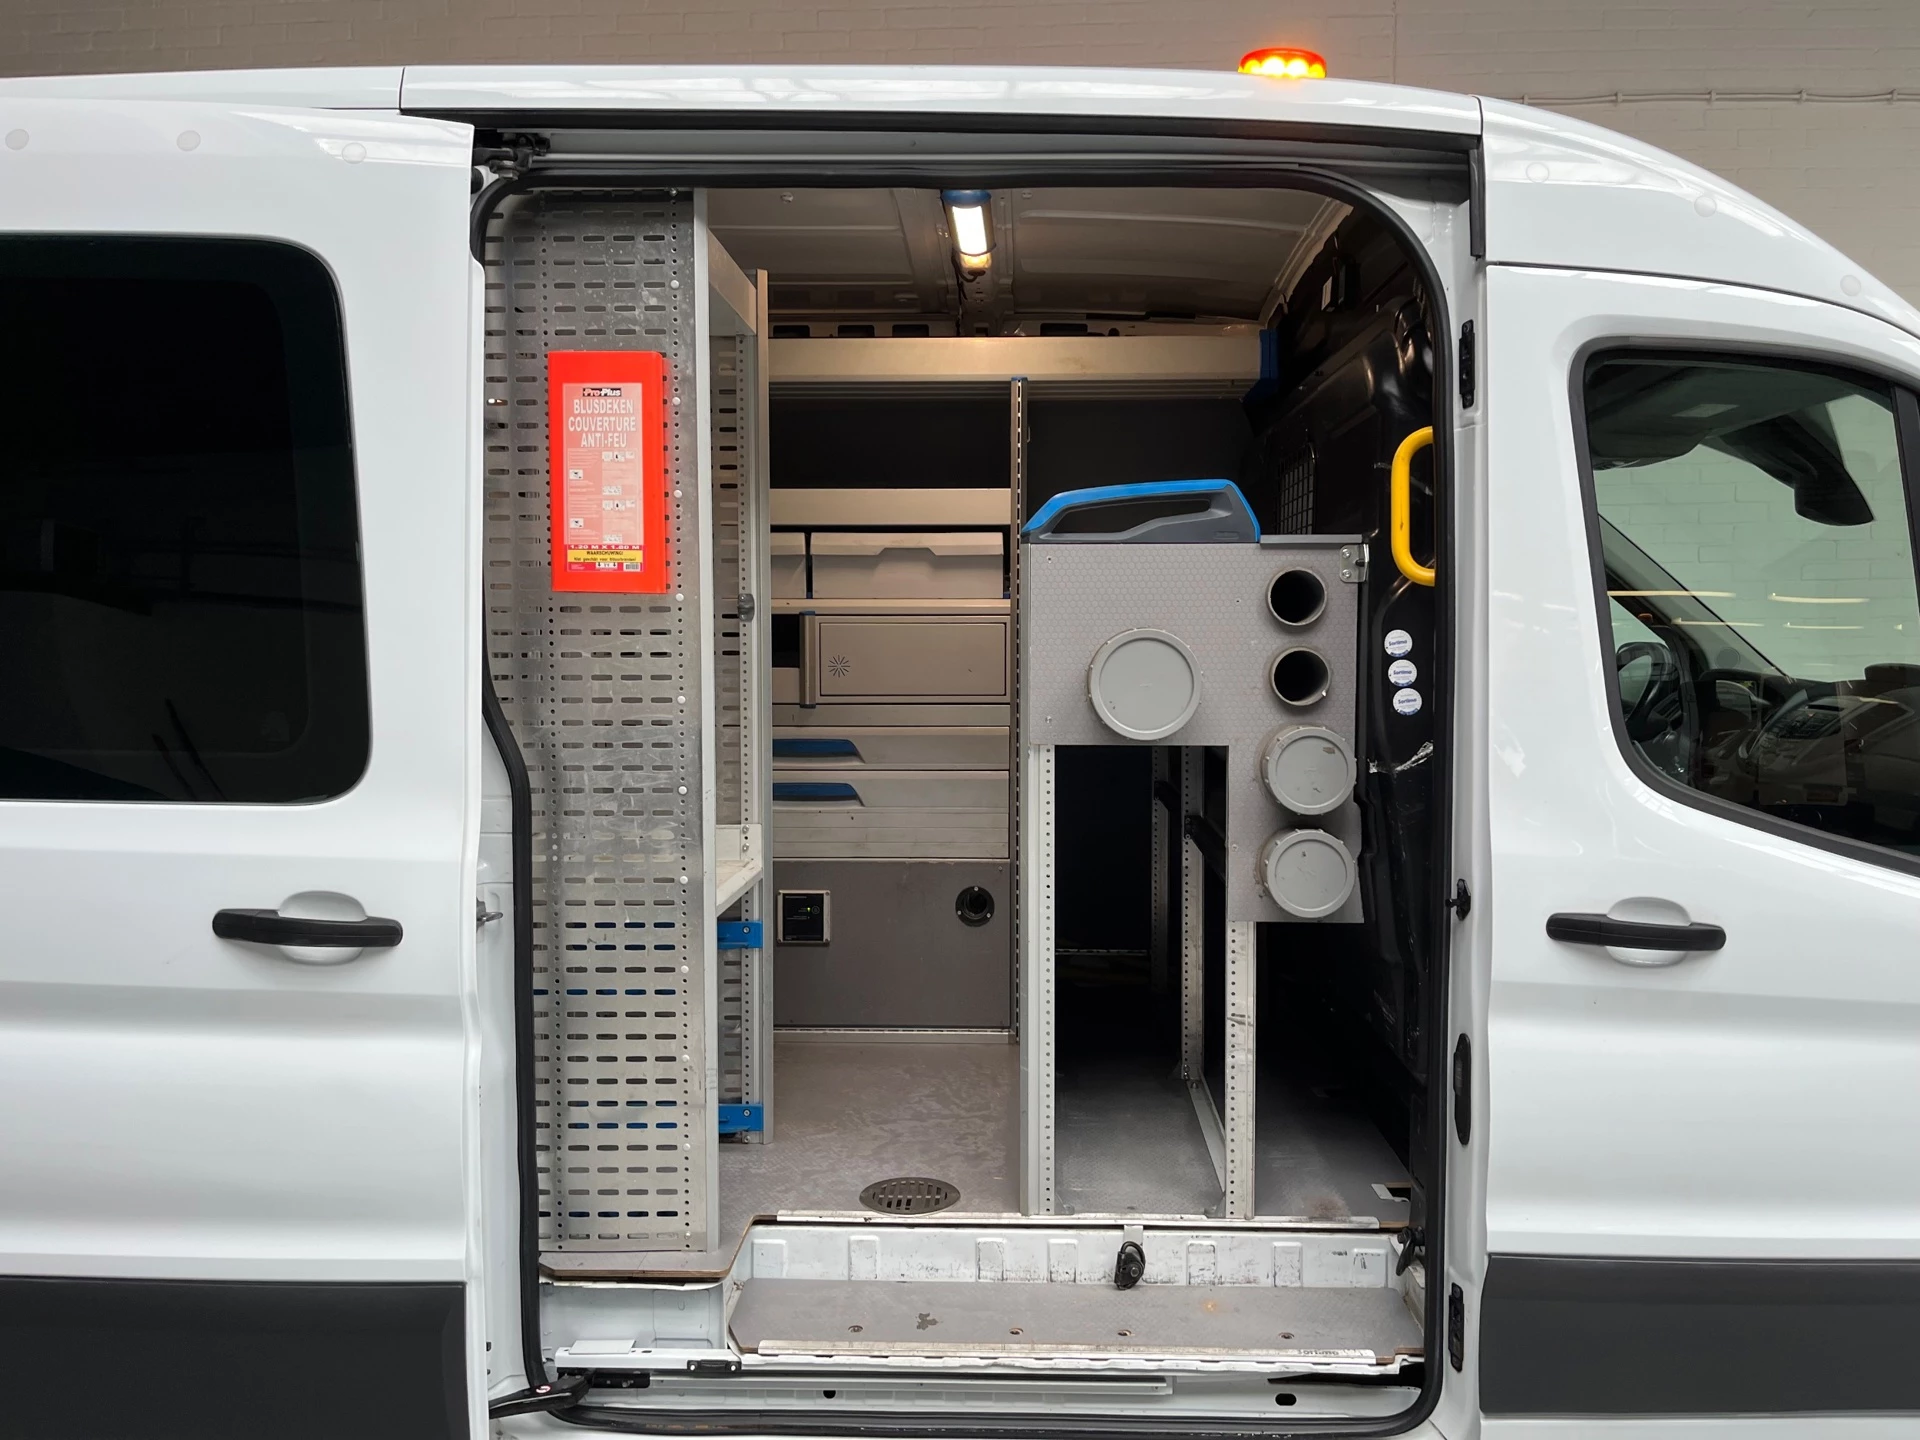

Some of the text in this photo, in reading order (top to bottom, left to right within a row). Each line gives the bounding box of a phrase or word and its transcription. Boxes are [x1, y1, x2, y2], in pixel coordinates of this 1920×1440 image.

[574, 399, 633, 414] BLUSDEKEN
[568, 416, 636, 431] COUVERTURE
[581, 433, 627, 448] ANTI-FEU
